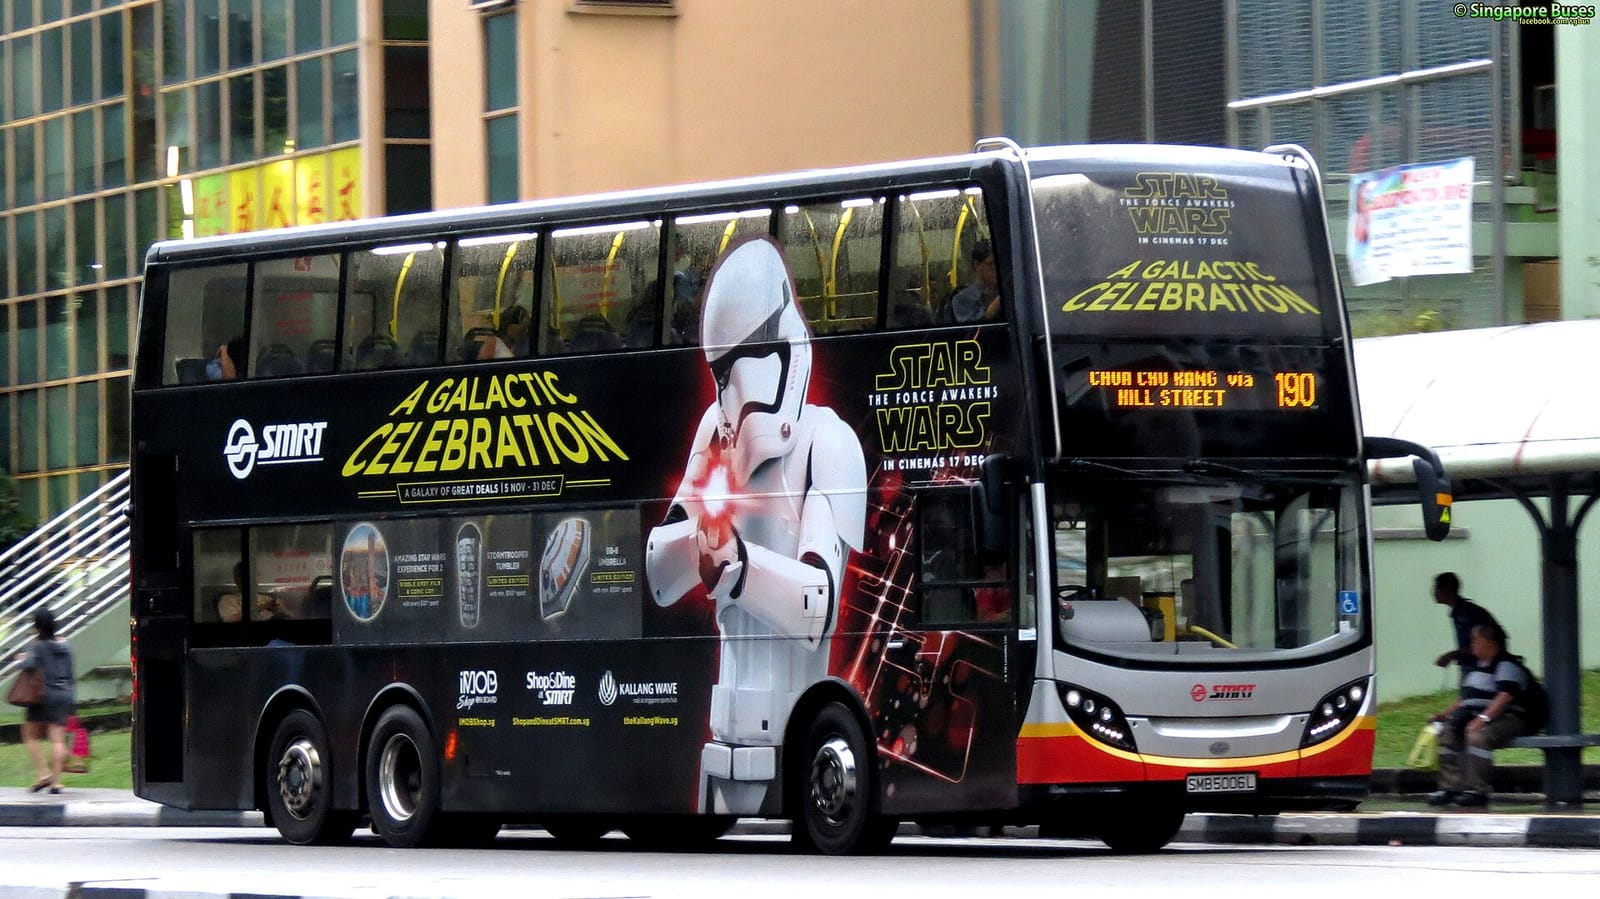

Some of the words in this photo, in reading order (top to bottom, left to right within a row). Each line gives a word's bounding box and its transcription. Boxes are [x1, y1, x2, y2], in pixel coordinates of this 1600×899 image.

[1124, 172, 1228, 199] STAR
[1120, 198, 1138, 206] THE
[1146, 198, 1180, 206] FORCE
[1186, 200, 1235, 208] AWAKENS
[1128, 206, 1231, 234] WARS
[1106, 260, 1142, 280] A
[1142, 260, 1276, 282] GALACTIC
[1062, 282, 1321, 315] CELEBRATION
[876, 340, 990, 391] STAR
[1089, 370, 1133, 386] CHUA
[1137, 370, 1168, 386] CHU
[1173, 370, 1218, 386] KANG
[1226, 371, 1254, 387] via
[388, 380, 429, 416] A
[426, 370, 578, 414] GALACTIC
[868, 394, 888, 406] THE
[896, 390, 934, 404] FORCE
[941, 386, 998, 402] AWAKENS
[1118, 390, 1154, 406] HILL
[1160, 390, 1226, 406] STREET
[1274, 372, 1316, 408] 190
[876, 402, 990, 452] WARS
[257, 422, 328, 459] SMRT
[342, 410, 630, 477] CELEBRATION
[884, 460, 894, 471] IN
[898, 456, 944, 470] CINEMAS
[949, 456, 959, 466] 17
[964, 454, 985, 466] DEC
[404, 488, 410, 498] A
[411, 486, 438, 497] GALAXY
[440, 486, 450, 496] OF
[451, 485, 474, 496] GREAT
[476, 484, 498, 494] DEALS
[510, 482, 526, 492] NOV
[532, 481, 540, 491] 31
[541, 481, 556, 490] DEC
[418, 553, 430, 561] STAR
[487, 551, 528, 560] STORMTROOPER
[598, 558, 626, 566] UMBRELLA
[397, 564, 428, 573] EXPERIENCE
[428, 564, 439, 572] FOR
[496, 562, 520, 571] TUMBLER
[460, 670, 498, 694] iMOB
[526, 671, 575, 691] Shop&Dine
[619, 682, 653, 695] KALLANG
[655, 682, 678, 694] WAVE
[543, 690, 575, 705] SMRT
[1209, 684, 1256, 699] SMRT
[458, 717, 495, 727] iMOBShop.sg
[624, 717, 678, 726] theKallangWave.sg
[1188, 776, 1254, 791] SMB5006L
